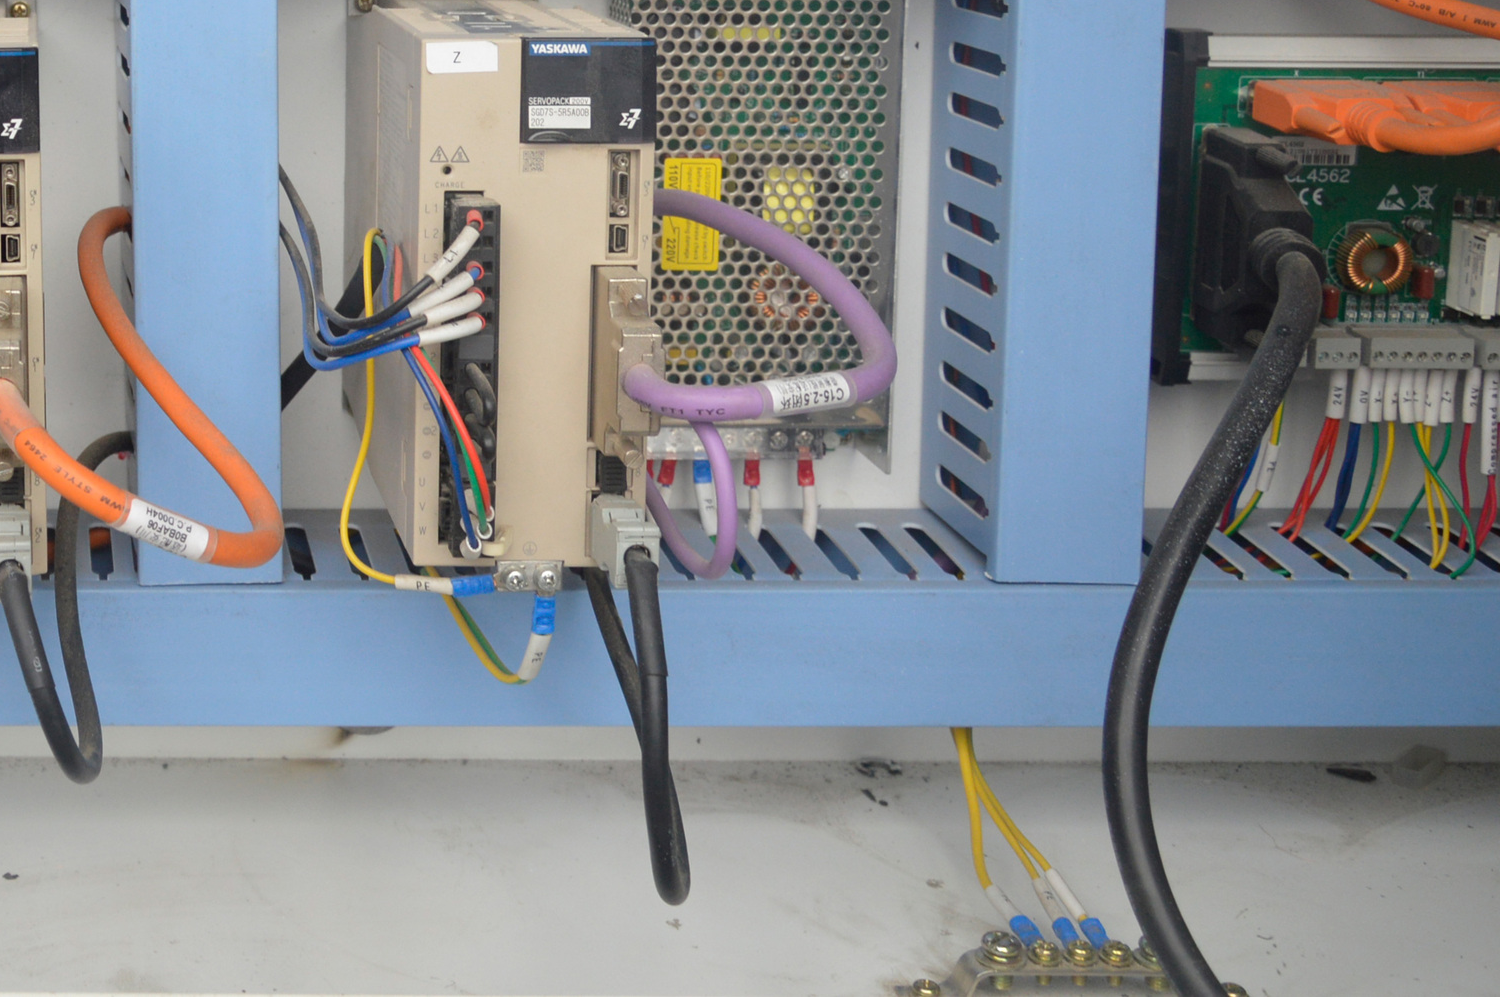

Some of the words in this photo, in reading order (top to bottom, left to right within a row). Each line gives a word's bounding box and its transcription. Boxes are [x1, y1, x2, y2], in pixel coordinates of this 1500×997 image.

[1473, 18, 1497, 28] AWM
[530, 43, 588, 55] YASKAWA
[453, 51, 461, 64] Z
[528, 97, 570, 105] SERVOPACK
[530, 118, 544, 127] 202
[669, 165, 678, 190] 110V
[424, 204, 438, 214] L1
[424, 229, 439, 239] L2
[666, 238, 676, 263] 220V
[1333, 386, 1343, 405] 24V
[1360, 390, 1369, 403] 0V
[1470, 388, 1478, 407] 24V
[1491, 380, 1499, 403] air
[660, 406, 684, 415] FT1
[696, 408, 726, 416] TYC
[1488, 405, 1498, 475] Compressed
[24, 440, 48, 461] 2464
[54, 466, 92, 494] STYLE
[418, 477, 426, 487] U
[420, 502, 426, 511] V
[419, 526, 427, 536] W
[416, 581, 430, 591] PE
